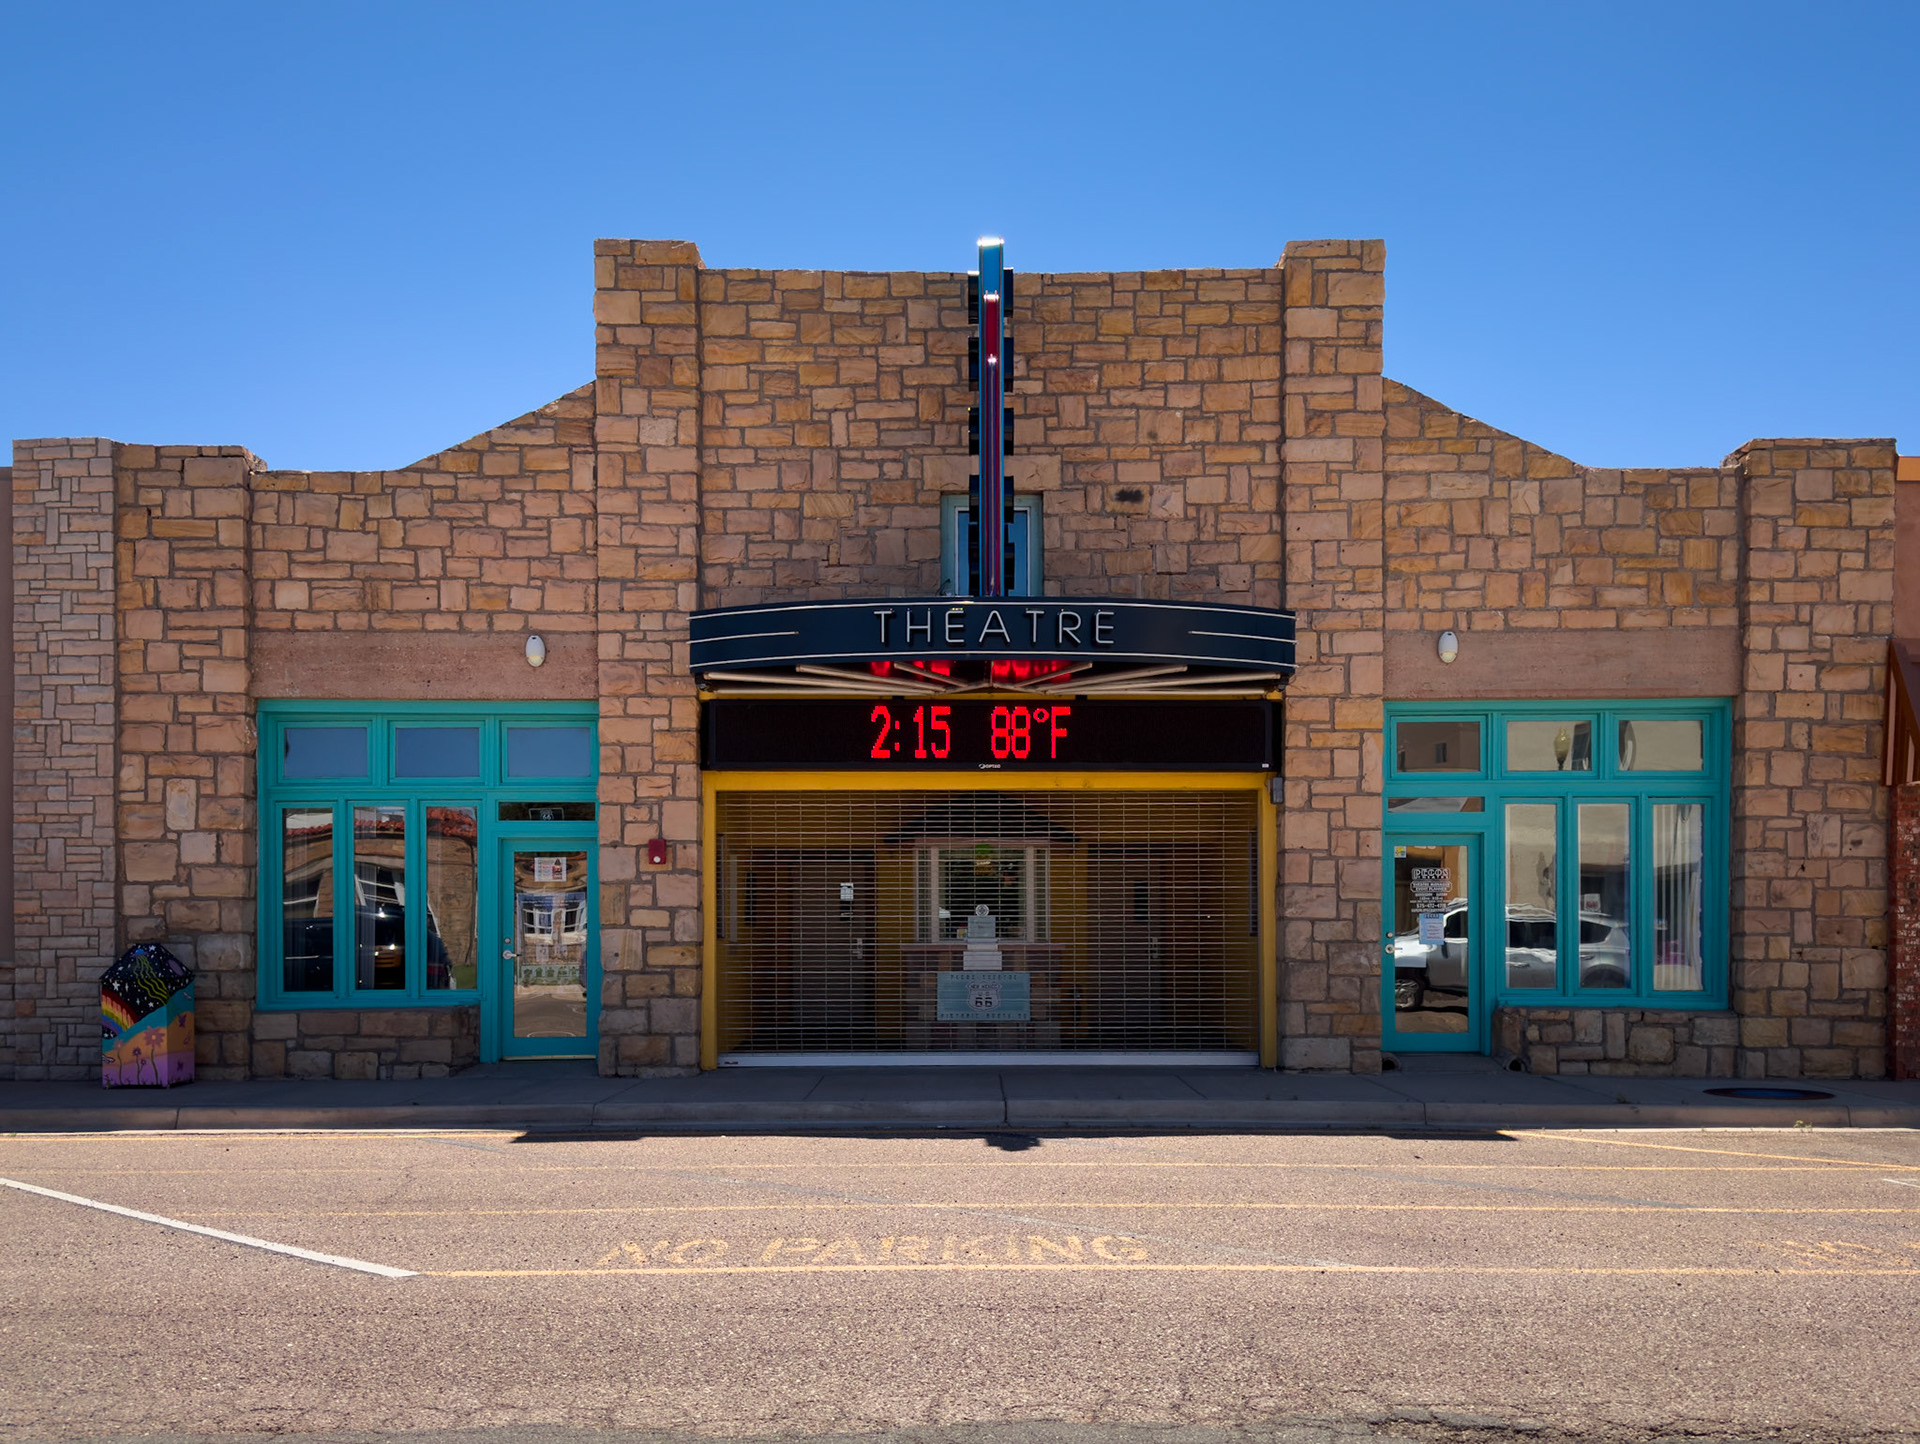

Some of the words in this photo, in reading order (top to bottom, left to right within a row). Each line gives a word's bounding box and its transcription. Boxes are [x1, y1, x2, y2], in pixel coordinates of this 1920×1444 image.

[873, 608, 1115, 646] THEATRE
[871, 706, 951, 759] 2:15
[991, 706, 1071, 759] 88°F
[975, 997, 993, 1007] 66
[595, 1237, 728, 1264] NO
[758, 1235, 1148, 1262] PARKING
